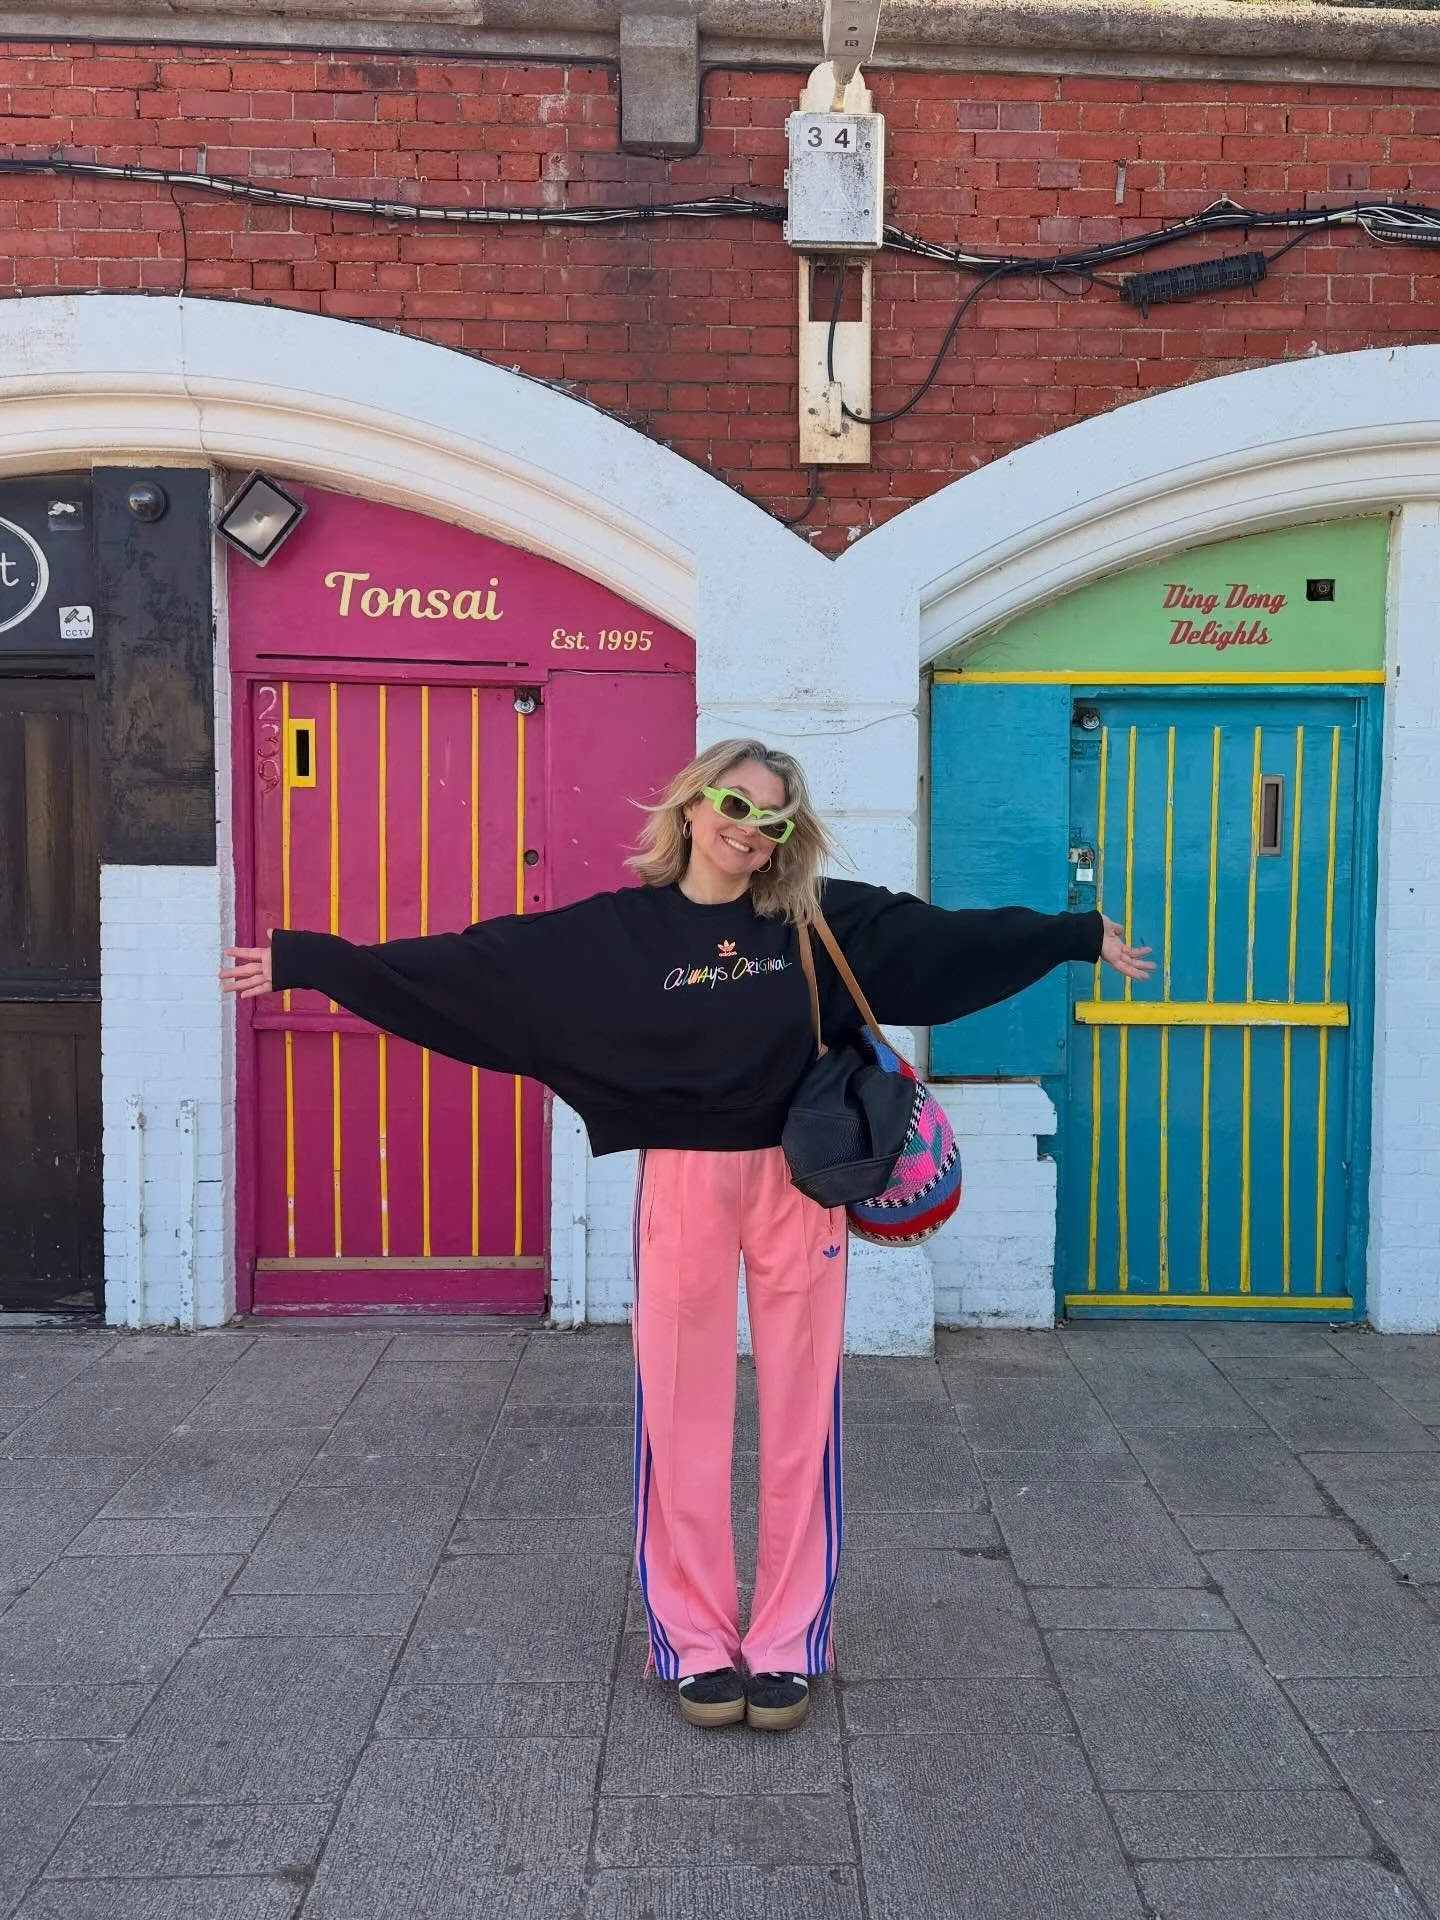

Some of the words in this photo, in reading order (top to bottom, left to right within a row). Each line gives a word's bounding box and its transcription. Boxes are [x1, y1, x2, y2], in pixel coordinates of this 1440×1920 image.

[324, 570, 504, 621] Tonsai
[1162, 583, 1221, 615] Ding
[1224, 583, 1289, 615] Dong
[65, 629, 90, 637] CCTV
[550, 628, 590, 651] Est.
[598, 629, 654, 652] 1995
[1169, 619, 1273, 651] Delights
